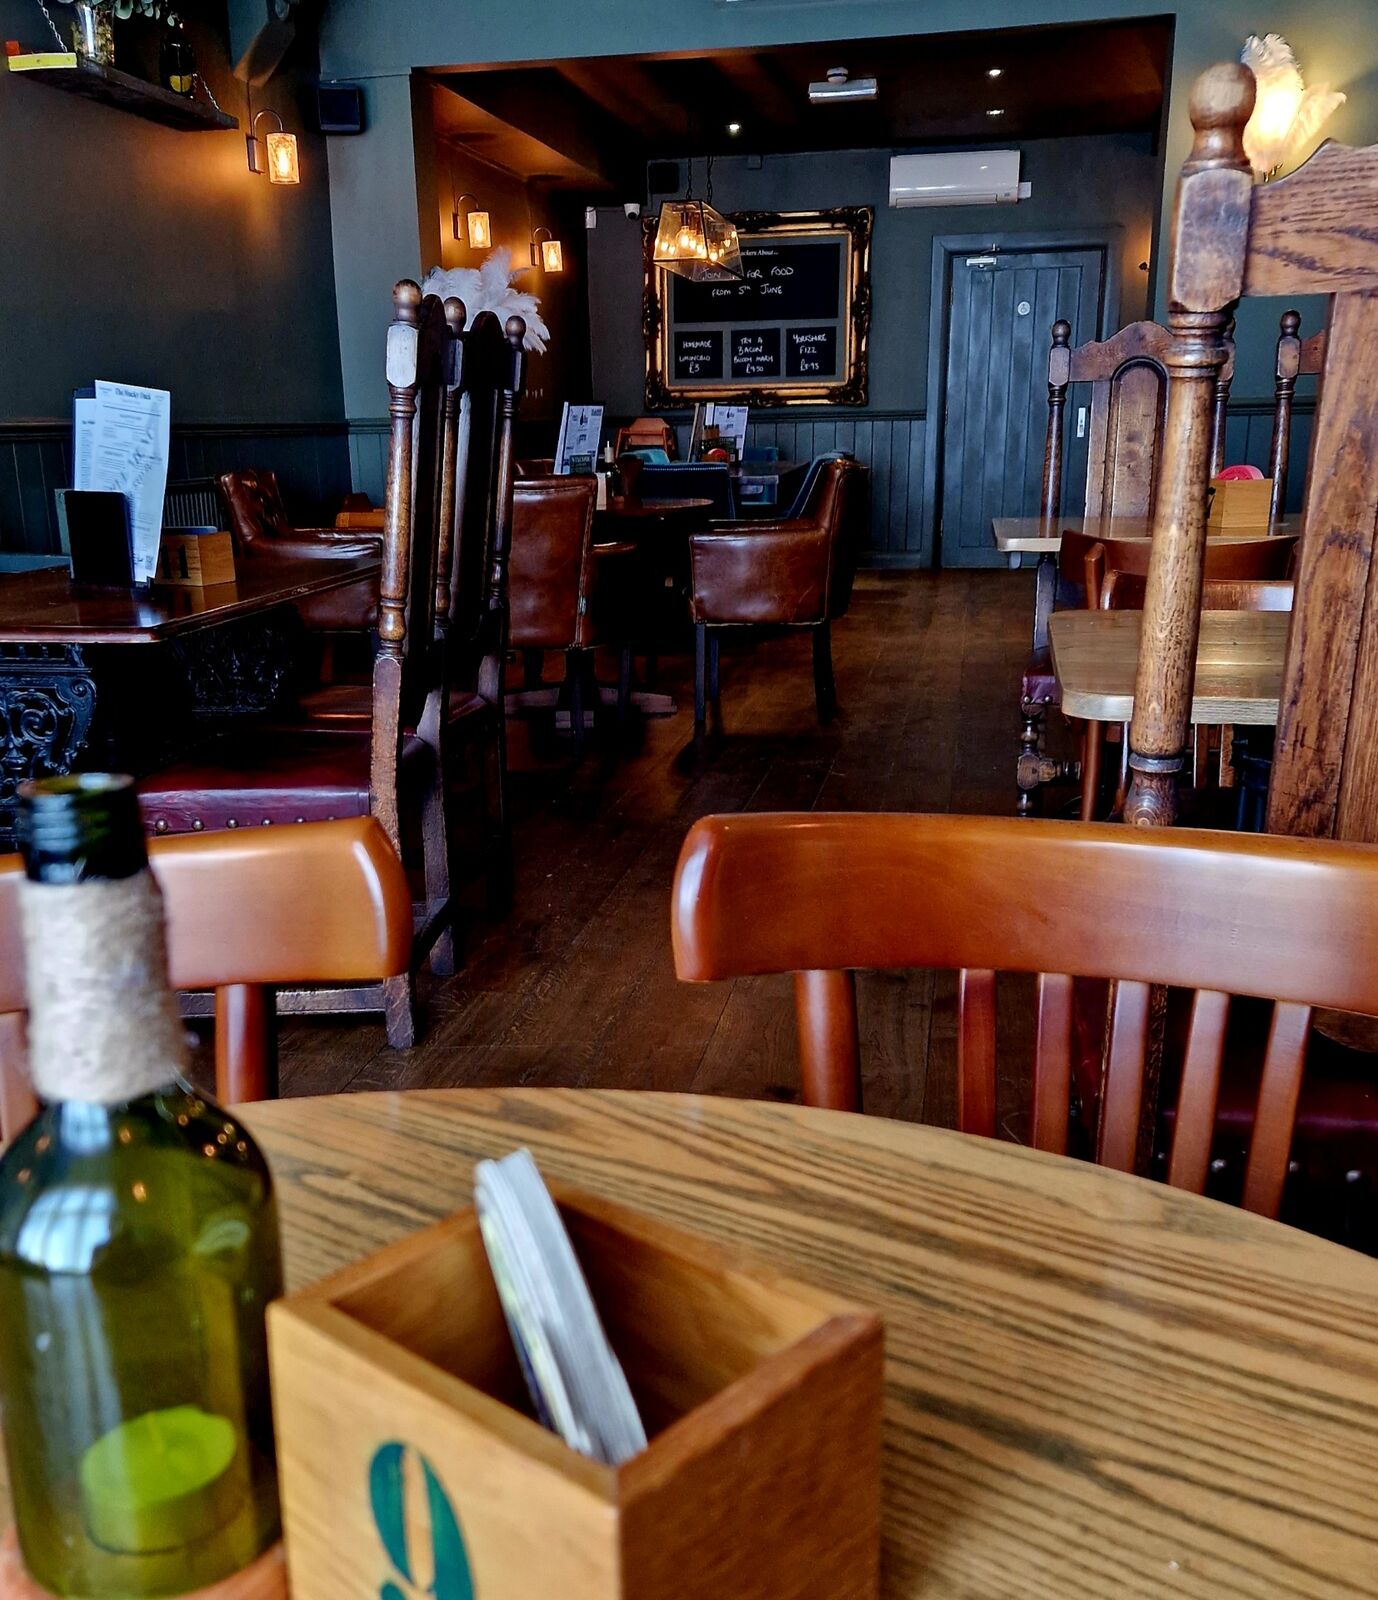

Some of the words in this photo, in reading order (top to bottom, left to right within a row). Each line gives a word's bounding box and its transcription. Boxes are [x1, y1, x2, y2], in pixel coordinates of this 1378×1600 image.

[747, 269, 763, 279] FOR
[770, 266, 794, 277] FOOD
[712, 288, 732, 298] FROM
[760, 283, 783, 295] JUNE
[757, 336, 763, 344] A
[738, 346, 763, 356] BACON
[799, 346, 818, 354] FIZZ
[367, 1439, 475, 1600] 9
